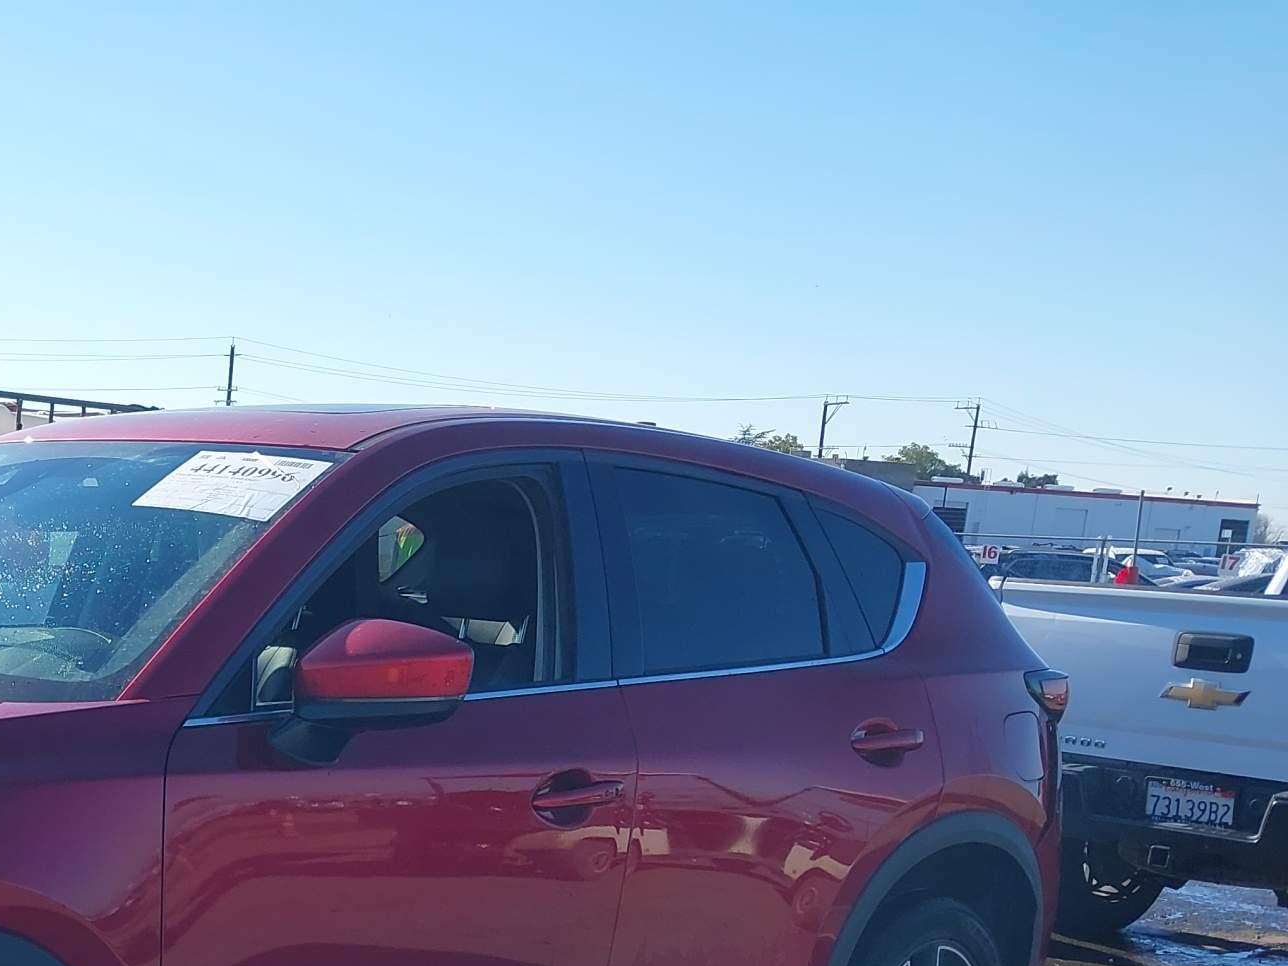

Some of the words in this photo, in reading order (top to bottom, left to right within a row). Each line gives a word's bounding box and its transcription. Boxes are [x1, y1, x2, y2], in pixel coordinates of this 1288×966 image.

[982, 545, 998, 559] 16
[1221, 556, 1241, 571] 17
[1150, 794, 1231, 826] 73139B2
